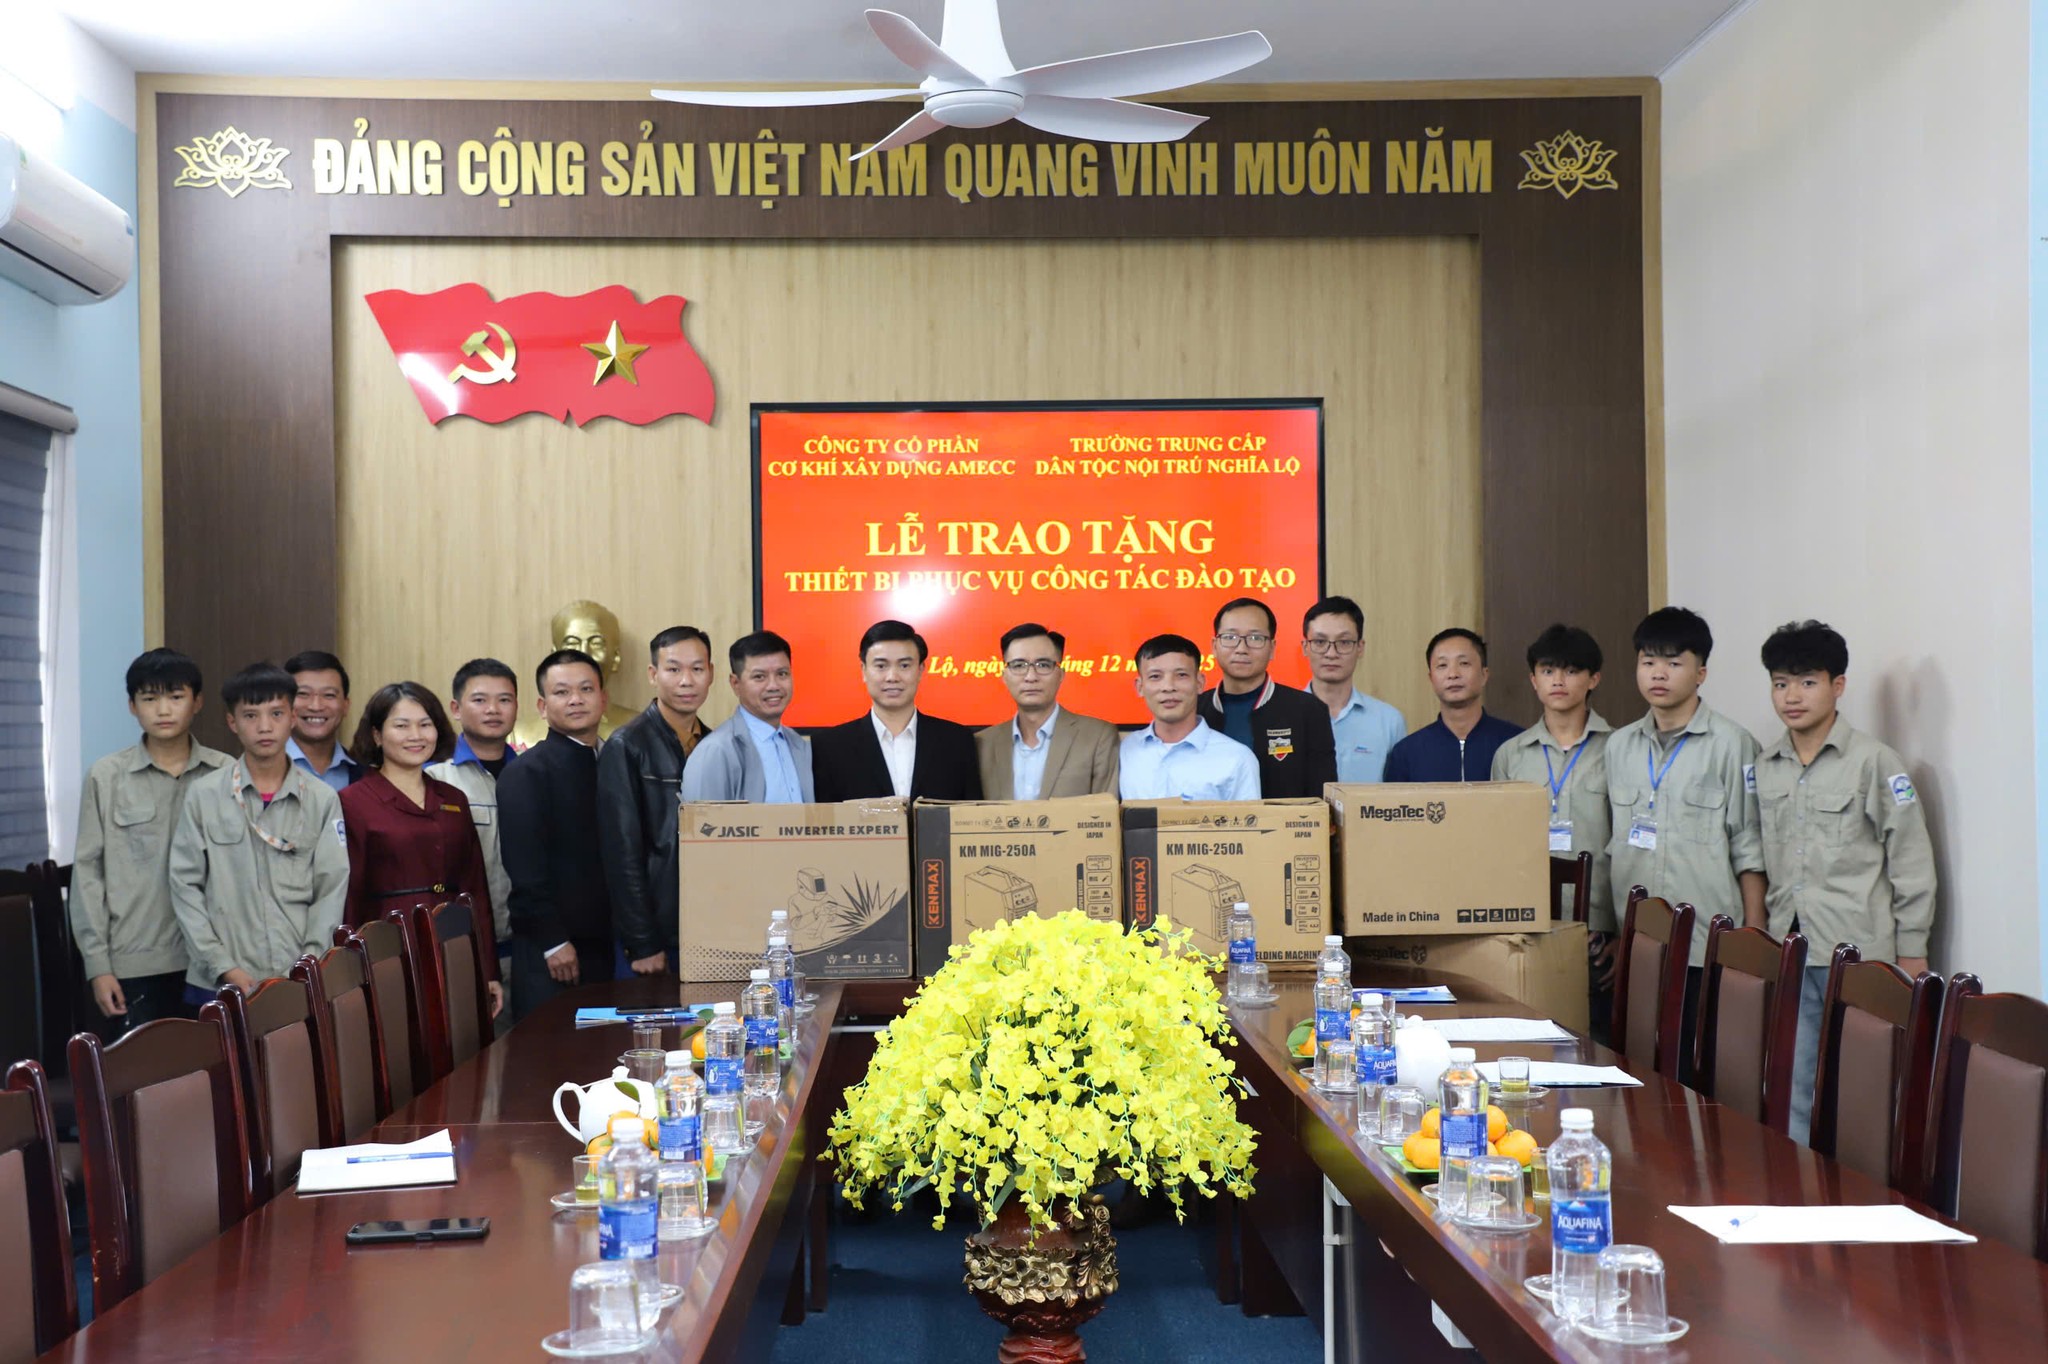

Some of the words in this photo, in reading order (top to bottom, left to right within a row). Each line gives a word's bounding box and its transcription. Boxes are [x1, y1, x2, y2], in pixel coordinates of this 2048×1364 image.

[313, 117, 444, 197] ĐẢNG
[458, 126, 586, 207] CỘNG
[600, 121, 696, 197] SẢN
[708, 128, 806, 209] VIỆT
[820, 142, 928, 198] NAM
[945, 142, 1098, 203] QUANG
[1111, 142, 1218, 196] VINH
[1233, 128, 1371, 195] MUÔN
[1385, 126, 1493, 194] NĂM
[803, 435, 860, 454] CÔNG
[864, 439, 890, 454] TY
[1069, 433, 1152, 453] TRƯỜNG
[1156, 436, 1223, 452] TRUNG
[1228, 432, 1267, 452] CẤP
[768, 459, 798, 476] CƠ
[801, 457, 837, 476] KHÍ
[841, 456, 883, 476] XÂY
[886, 458, 942, 479] DỰNG
[945, 459, 1016, 475] AMECC
[1035, 456, 1075, 475] DÂN
[1079, 457, 1120, 478] TỘC
[1124, 457, 1159, 478] NỘI
[1163, 455, 1202, 474] TRÚ
[1207, 455, 1270, 474] NGHĨA
[1273, 455, 1300, 476] LỘ
[865, 512, 926, 556] LỄ
[938, 520, 1071, 556] TRAO
[1082, 514, 1215, 563] TẶNG
[784, 565, 868, 592] THIẾT
[908, 570, 982, 596] PHỤC
[987, 570, 1024, 595] VỤ
[1030, 563, 1109, 590] CÔNG
[1115, 563, 1170, 589] TÁC
[1175, 562, 1234, 589] ĐÀO
[1239, 567, 1296, 593] TẠO
[928, 655, 958, 678] Lộ,
[963, 655, 1005, 678] ngày
[1060, 654, 1095, 677] áng
[1098, 654, 1122, 672] 12
[1360, 804, 1425, 821] MegaTec
[717, 826, 760, 837] JASIC
[779, 826, 844, 836] INVERTER
[849, 825, 899, 835] EXPERT
[1077, 821, 1105, 829] DESIGNED
[1285, 821, 1313, 829] DESIGNED
[1086, 831, 1103, 839] JAPAN
[959, 845, 977, 858] KM
[980, 844, 1036, 857] MIG-250A
[1166, 843, 1184, 856] KM
[1187, 842, 1244, 855] MIG-250A
[928, 862, 939, 925] KENMAX
[1135, 860, 1146, 922] KENMAX
[1362, 912, 1394, 923] Made
[1396, 912, 1406, 922] in
[1409, 911, 1440, 922] China
[1256, 951, 1284, 960] ELDING
[1558, 1214, 1604, 1231] AQUAFINA
